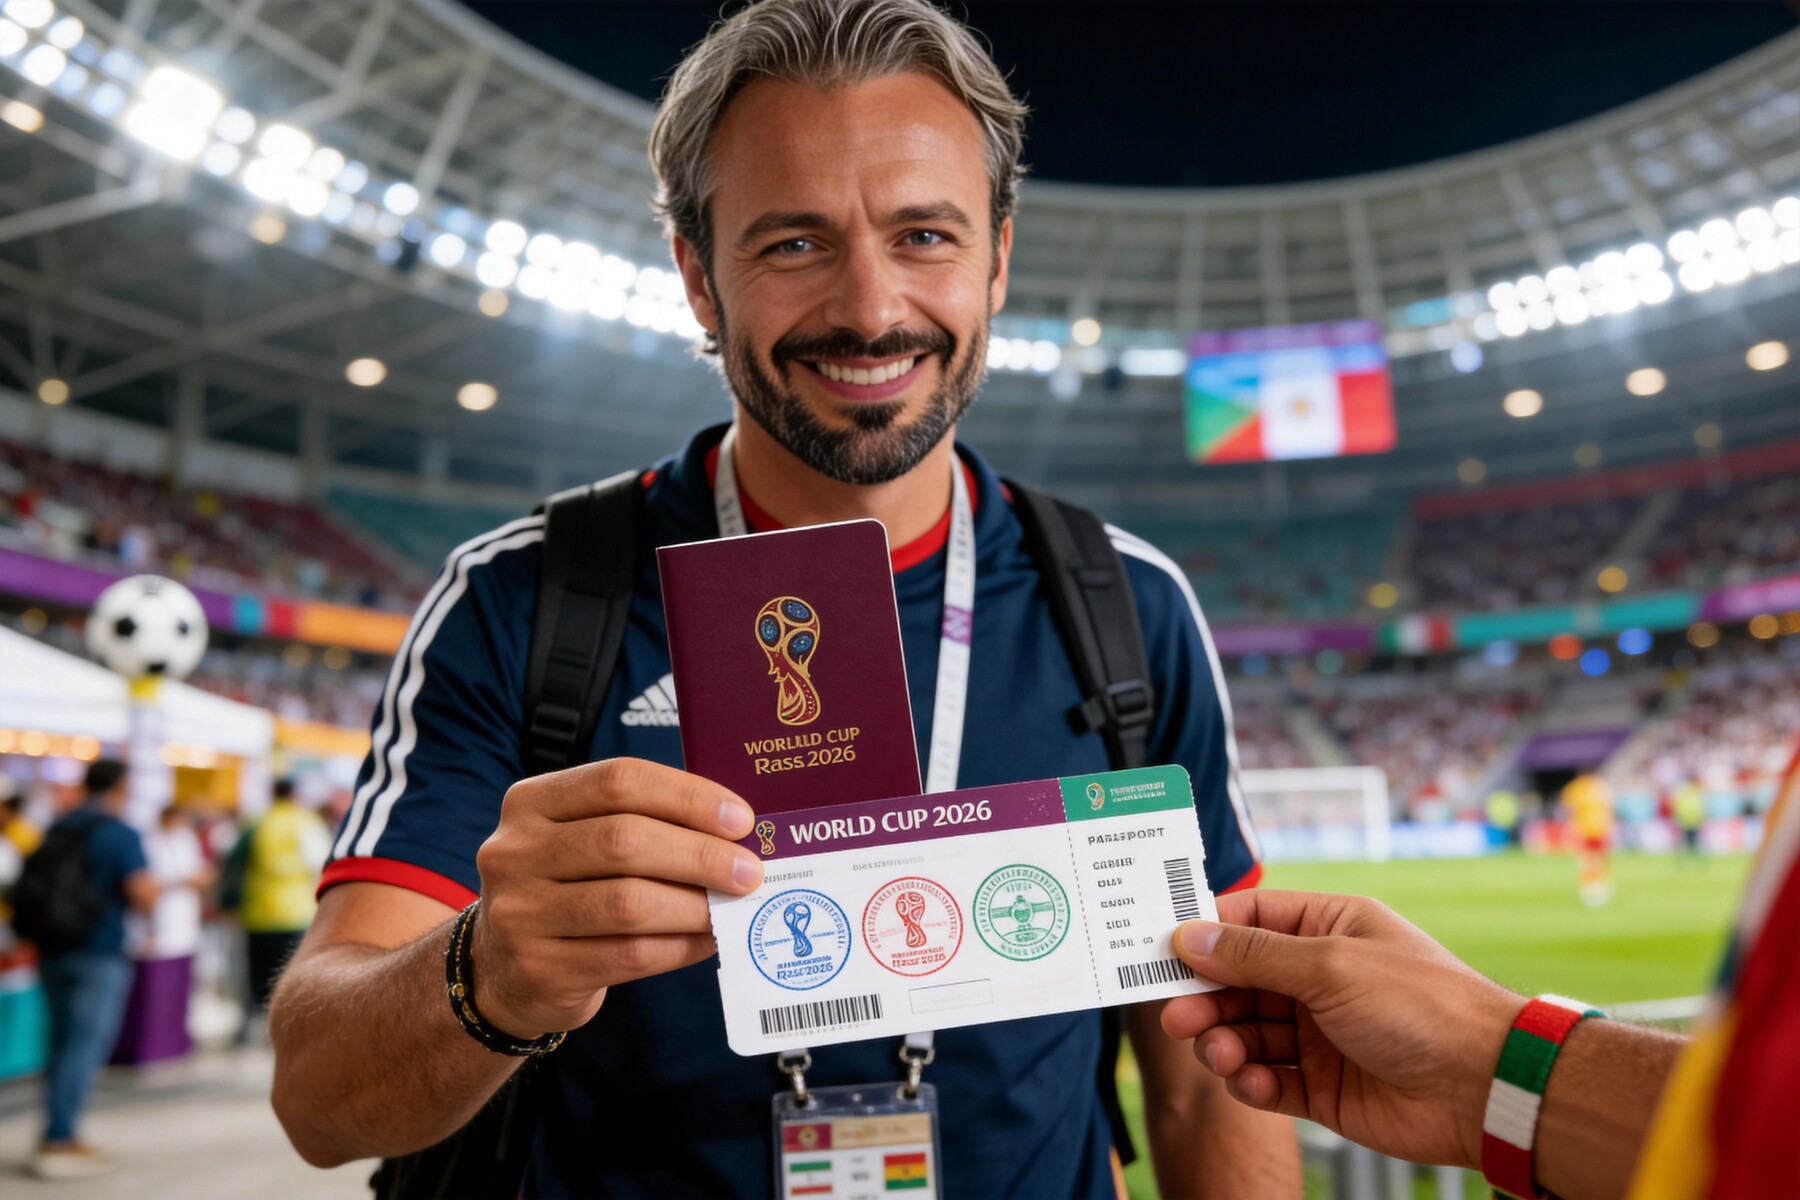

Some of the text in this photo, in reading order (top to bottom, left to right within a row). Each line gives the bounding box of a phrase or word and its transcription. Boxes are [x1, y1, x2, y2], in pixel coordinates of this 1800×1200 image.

[620, 709, 680, 727] adid
[826, 727, 860, 743] CUP
[754, 745, 856, 775] Rass 2026
[789, 800, 992, 845] WORLD CUP 2026
